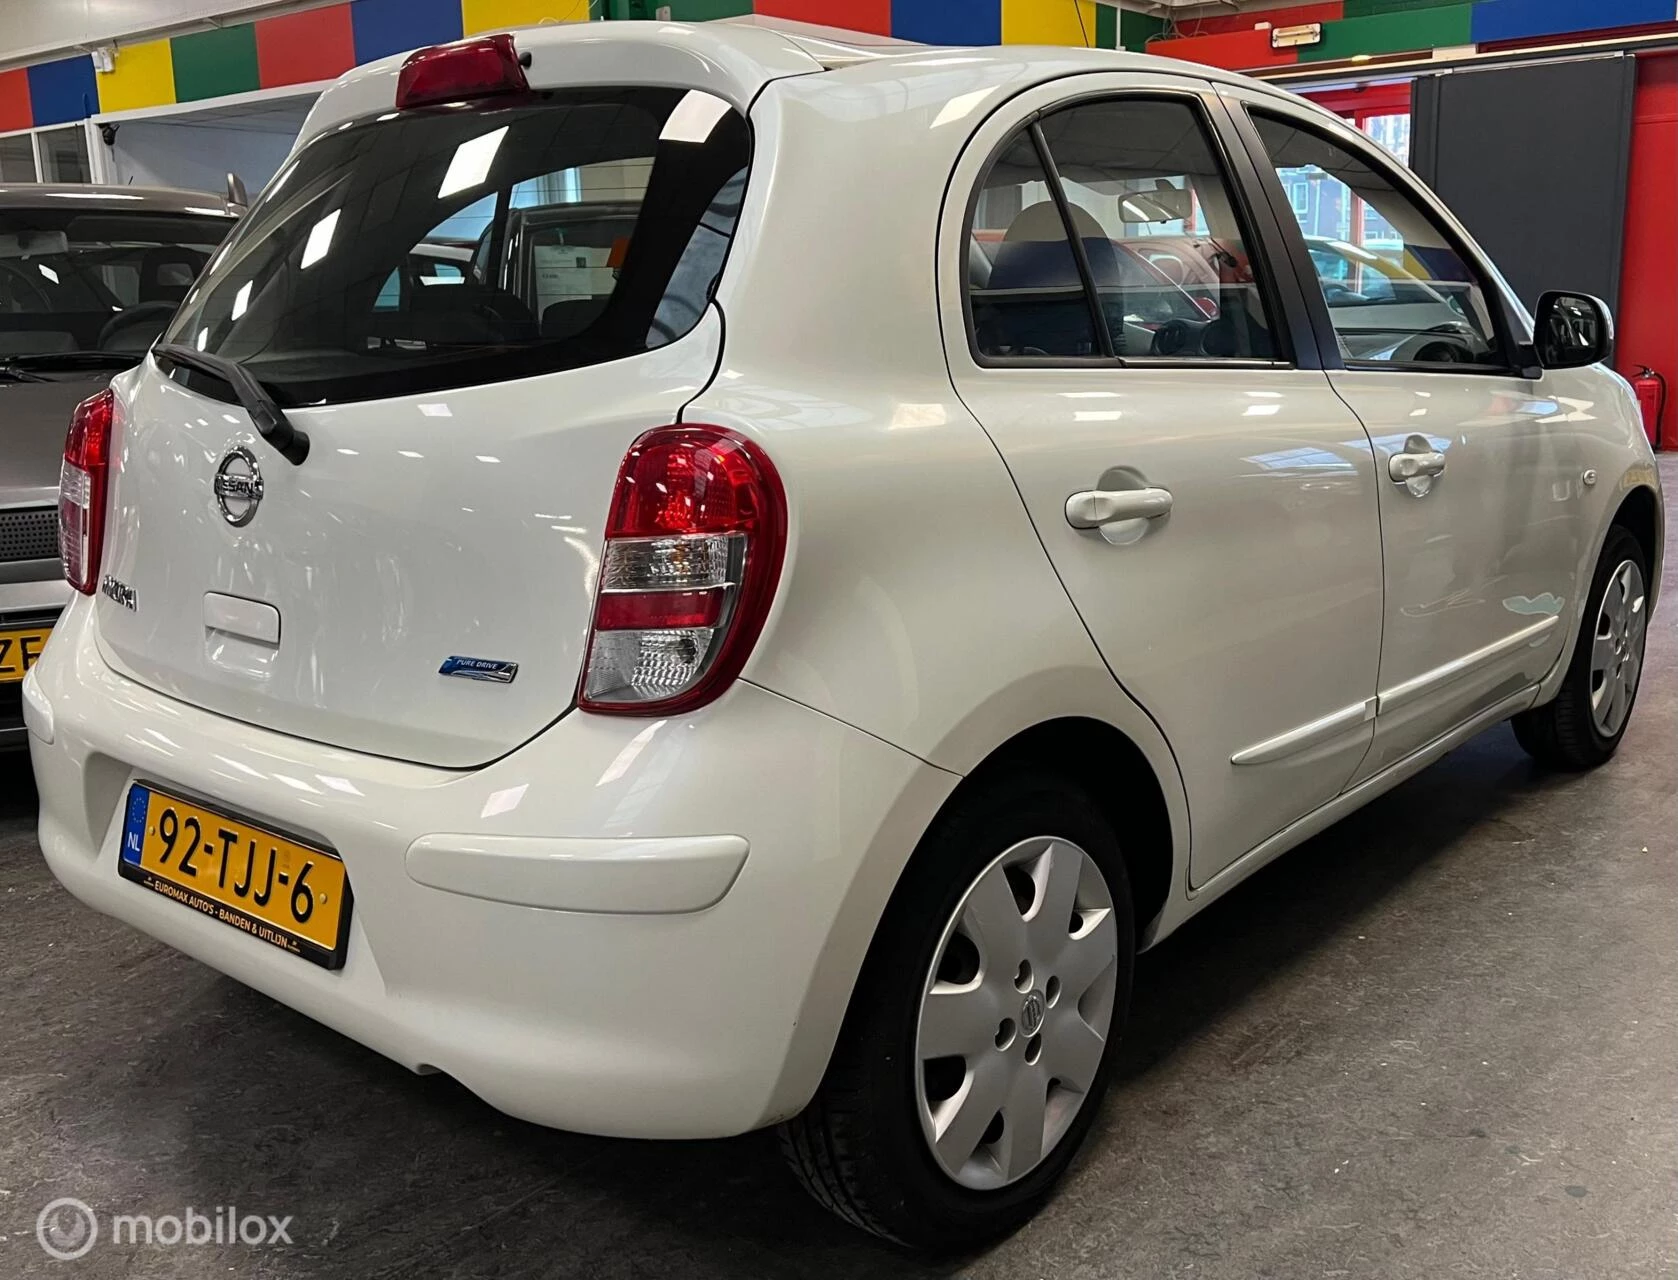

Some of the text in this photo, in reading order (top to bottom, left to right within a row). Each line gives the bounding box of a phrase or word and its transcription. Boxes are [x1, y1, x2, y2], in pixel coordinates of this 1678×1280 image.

[456, 659, 498, 670] PURE DRIVE
[128, 832, 141, 851] NL
[159, 807, 315, 924] 92-TJJ-6
[154, 880, 189, 904] EUROMAX
[188, 895, 214, 915] AUTO'S
[218, 908, 251, 931] BANDEN
[251, 923, 258, 934] &
[258, 926, 288, 948] UITLIJN
